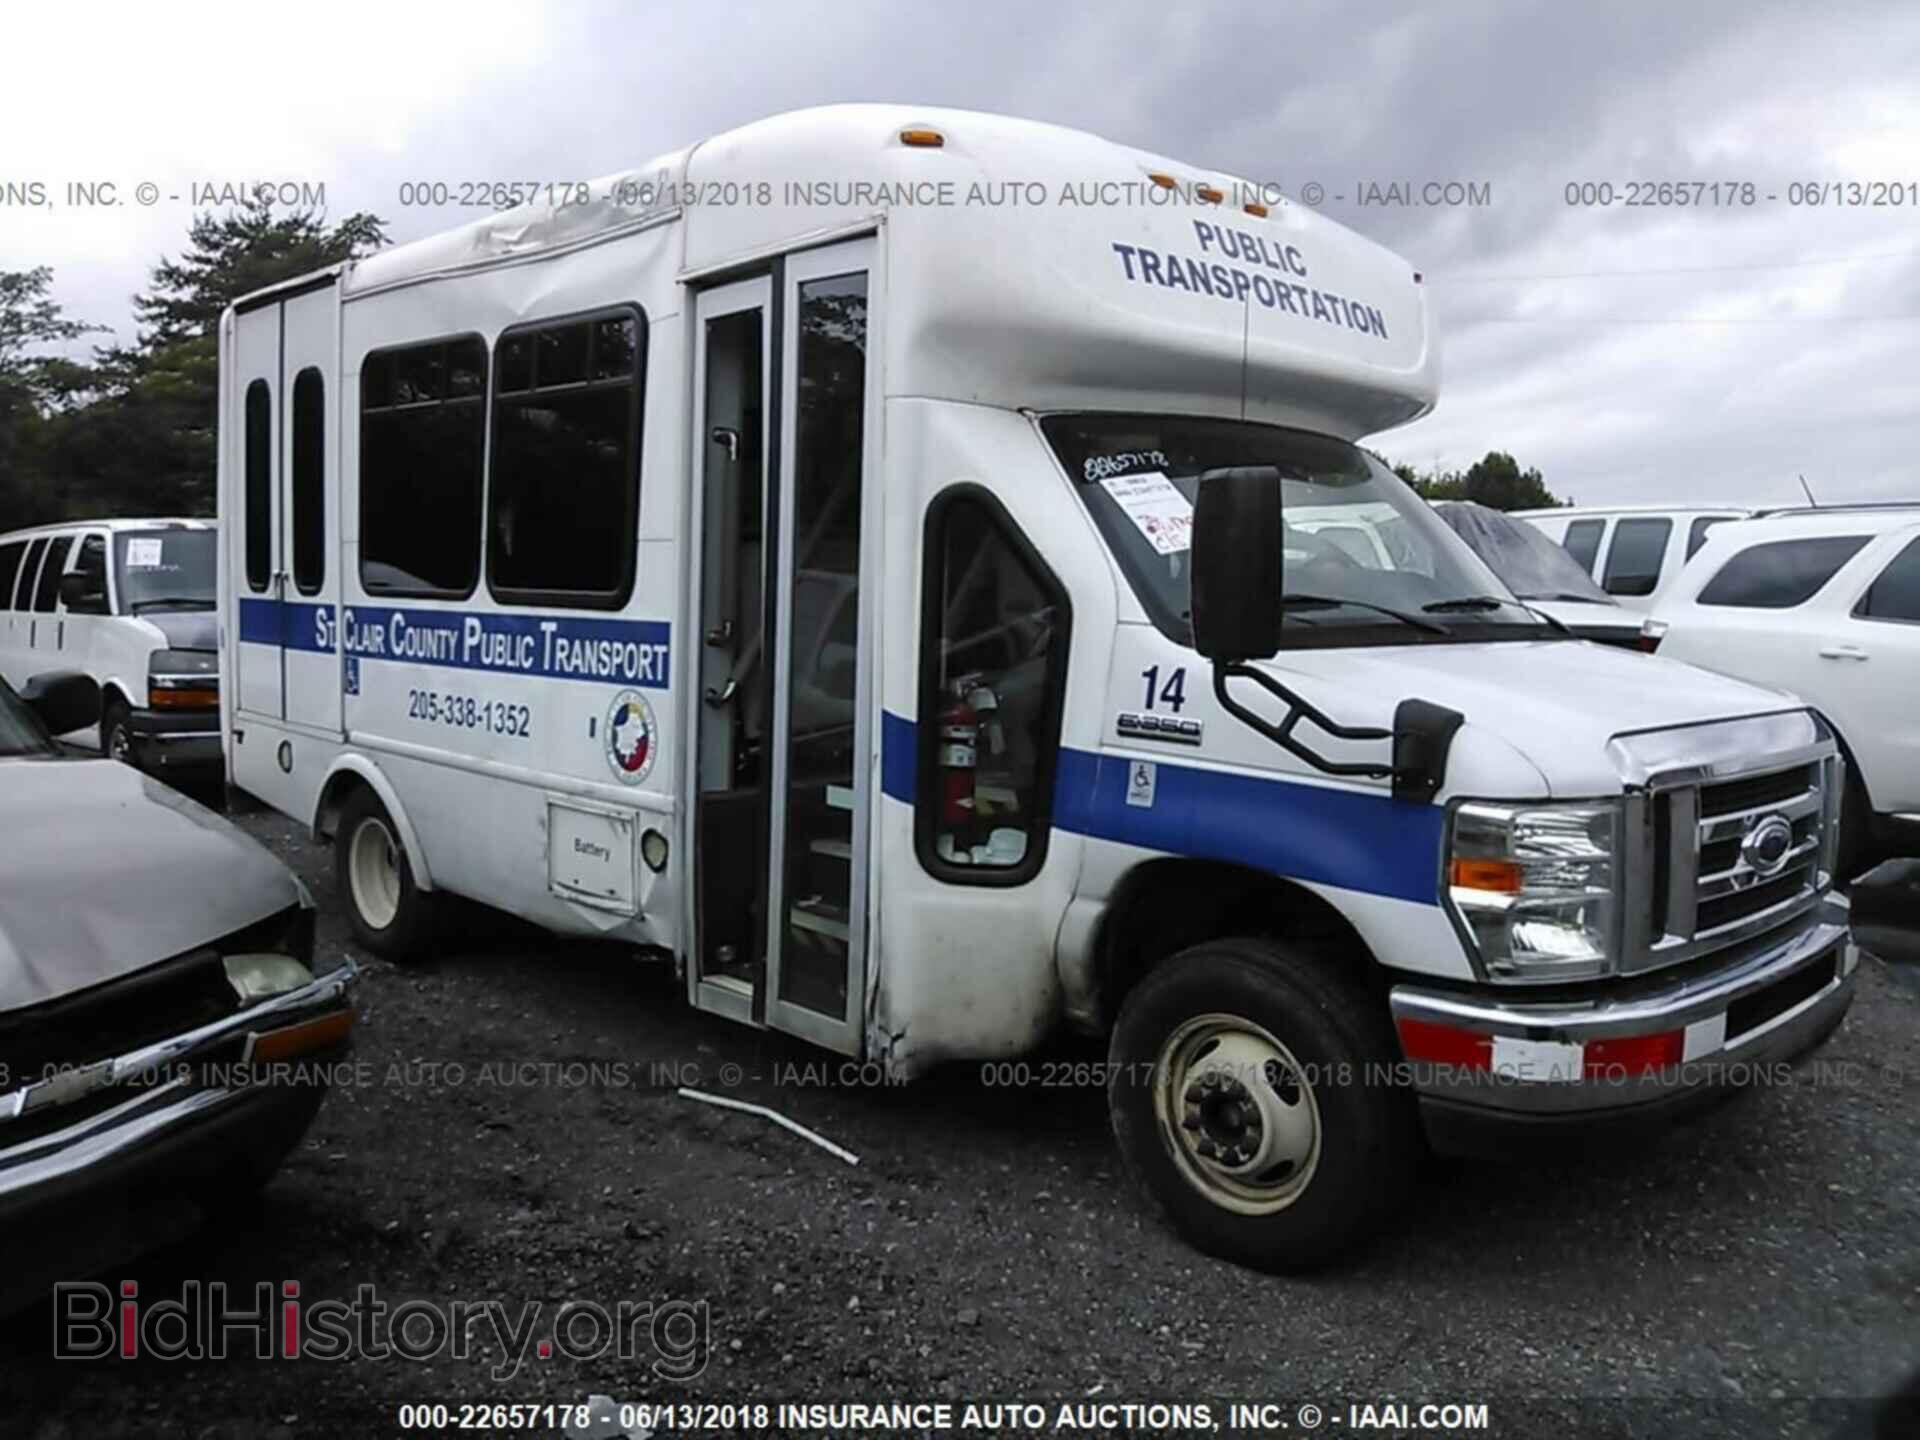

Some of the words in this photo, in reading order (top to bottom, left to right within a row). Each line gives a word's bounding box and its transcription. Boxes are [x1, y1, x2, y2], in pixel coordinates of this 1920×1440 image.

[1193, 219, 1307, 277] PUBLIC
[1111, 242, 1389, 340] TRANSPORTATION
[343, 609, 386, 654] CLAIR
[389, 612, 461, 660] COUNTY
[464, 616, 535, 669] PUBLIC
[540, 621, 669, 682] TRANSPORT
[408, 689, 531, 738] 205-338-1352
[1141, 664, 1187, 714] 14
